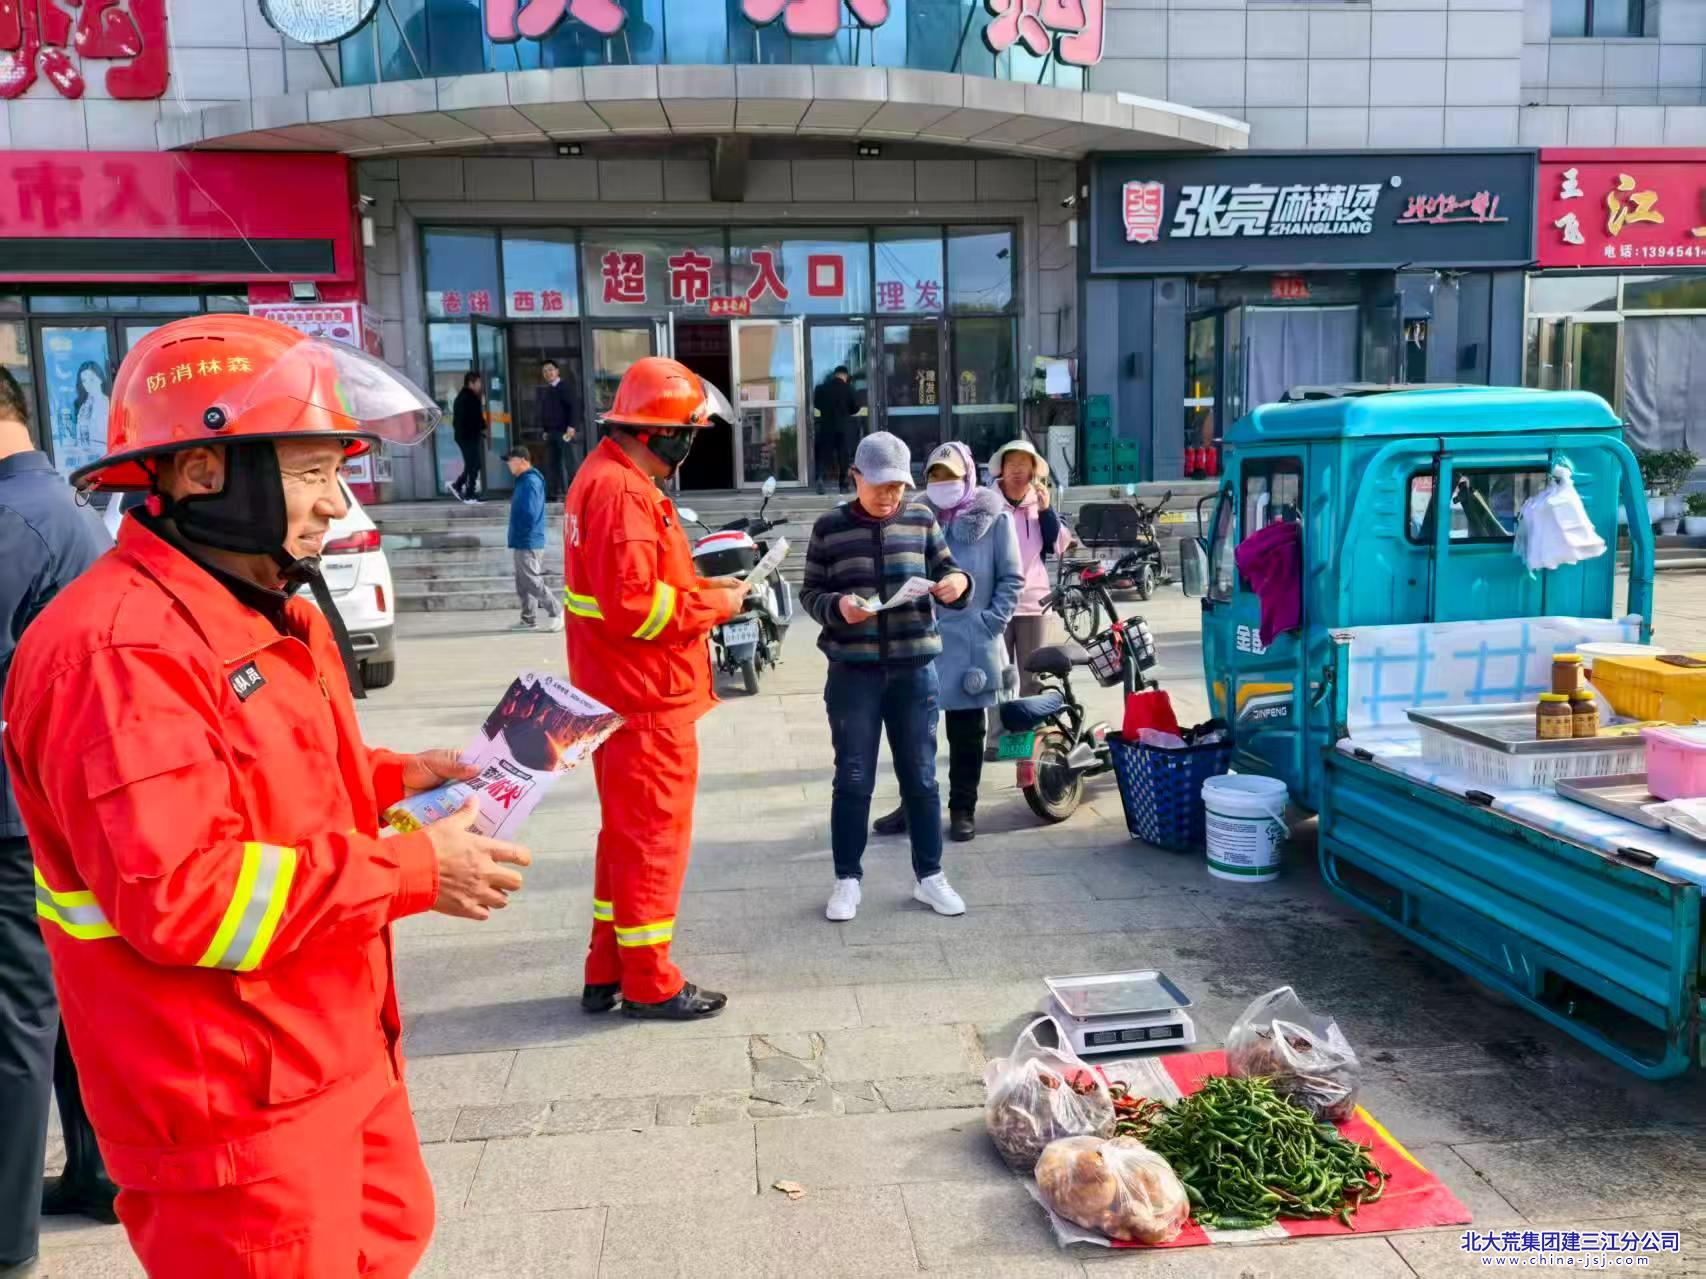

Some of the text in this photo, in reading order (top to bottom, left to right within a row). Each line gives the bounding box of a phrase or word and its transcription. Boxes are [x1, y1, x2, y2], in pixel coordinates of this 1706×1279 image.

[1170, 184, 1382, 237] 张亮麻辣烫
[1267, 221, 1373, 236] ZHANGLIANG
[601, 251, 844, 304] 超市入口
[513, 290, 563, 312] 西施
[877, 280, 941, 310] 理发
